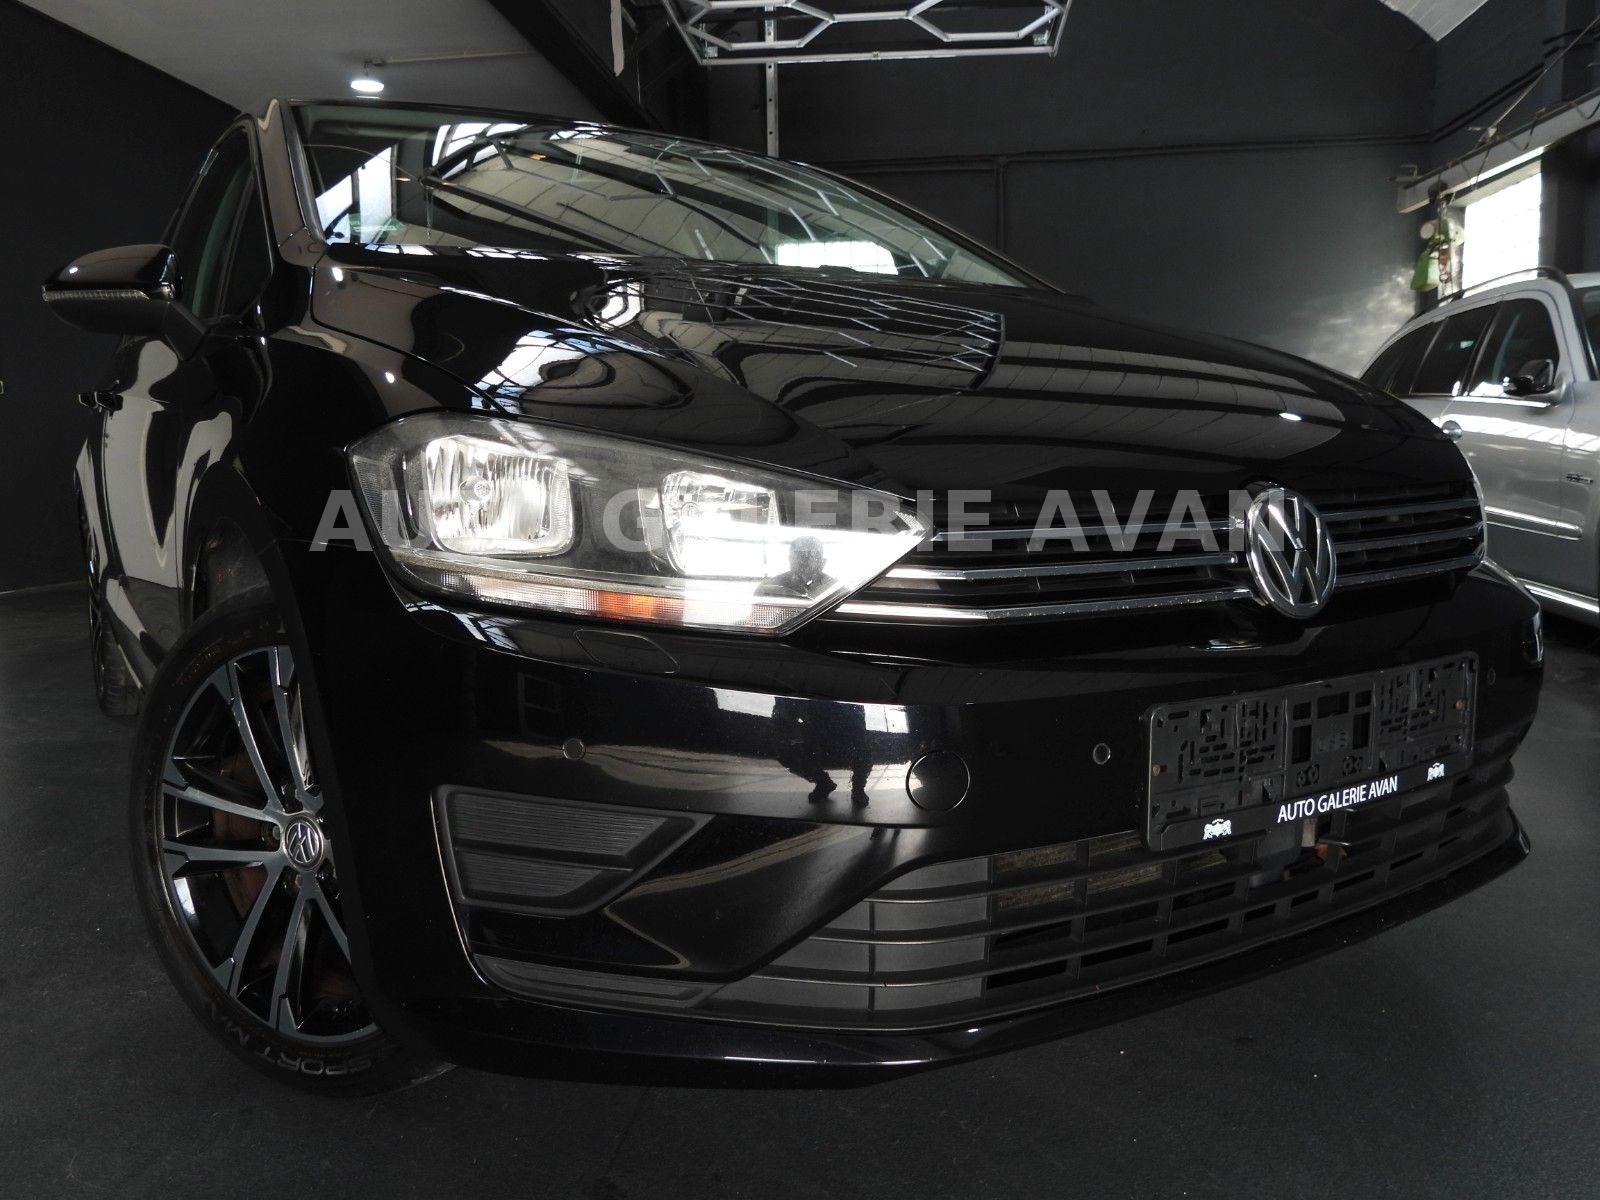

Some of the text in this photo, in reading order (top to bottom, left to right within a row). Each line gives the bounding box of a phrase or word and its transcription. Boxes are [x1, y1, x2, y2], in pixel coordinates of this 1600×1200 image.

[1277, 775, 1398, 824] AUTO GALERIE AVAN
